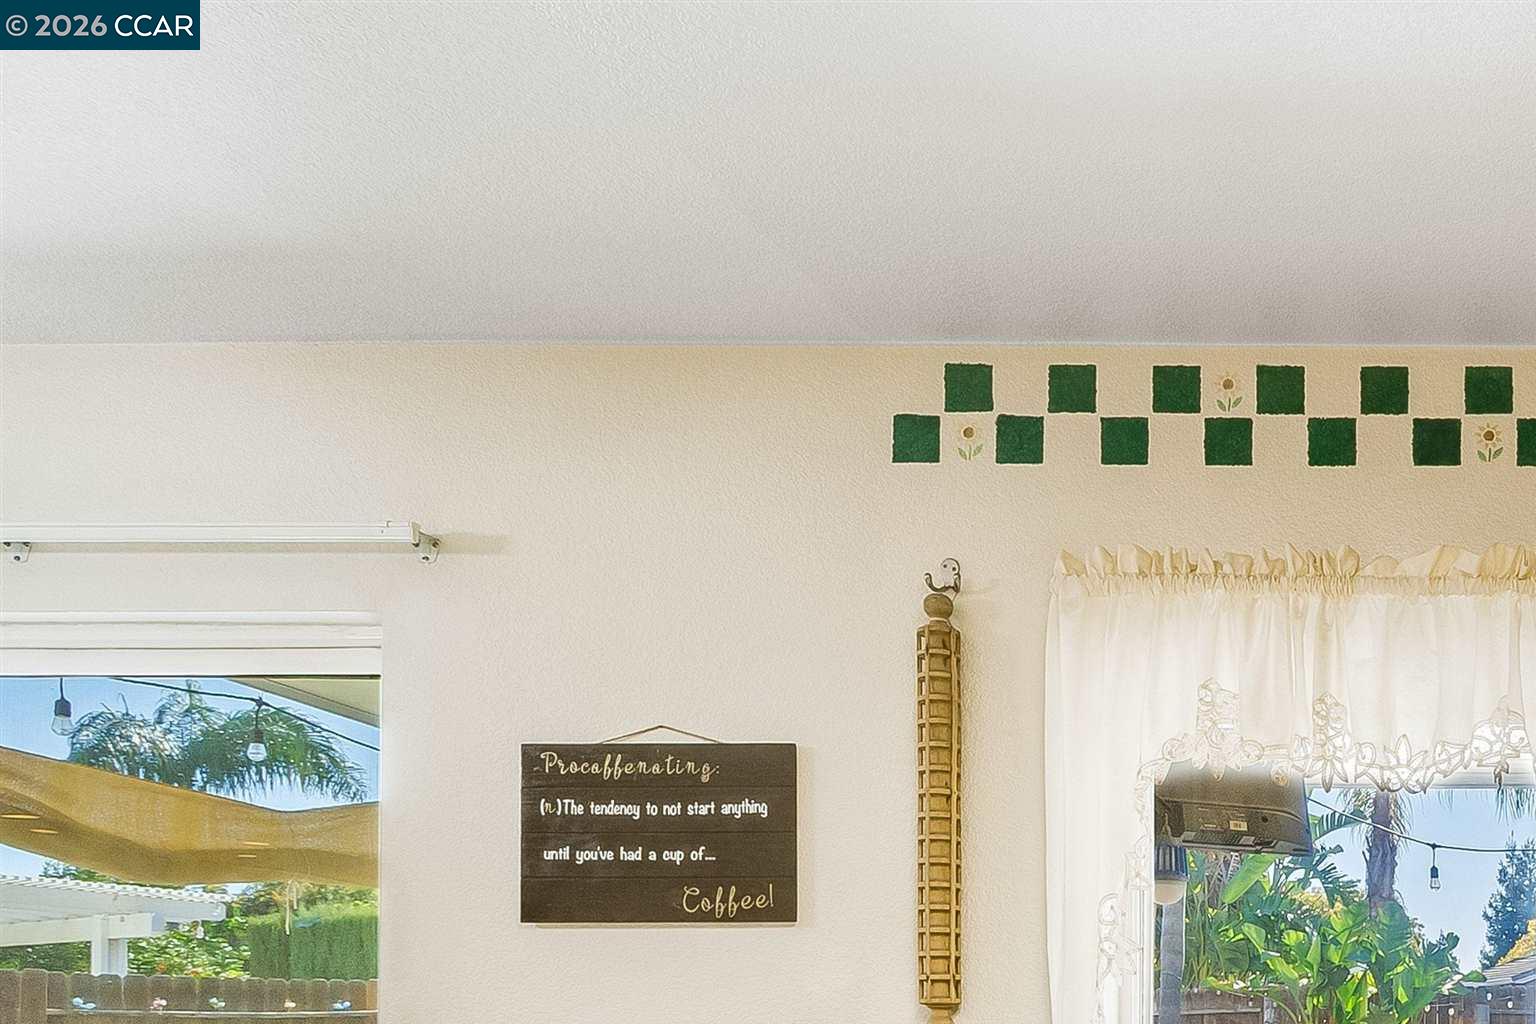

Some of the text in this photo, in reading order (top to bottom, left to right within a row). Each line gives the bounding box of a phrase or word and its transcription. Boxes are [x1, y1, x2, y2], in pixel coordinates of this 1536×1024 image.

[540, 751, 720, 783] Procaffenating:
[590, 800, 641, 820] tendency
[646, 801, 658, 816] to
[662, 801, 682, 816] not
[687, 801, 716, 816] start
[720, 798, 768, 819] anything
[543, 846, 570, 861] until
[575, 846, 614, 865] you've
[619, 846, 643, 861] had
[648, 850, 657, 861] a
[662, 850, 684, 865] cup
[682, 883, 774, 919] Coffee!
